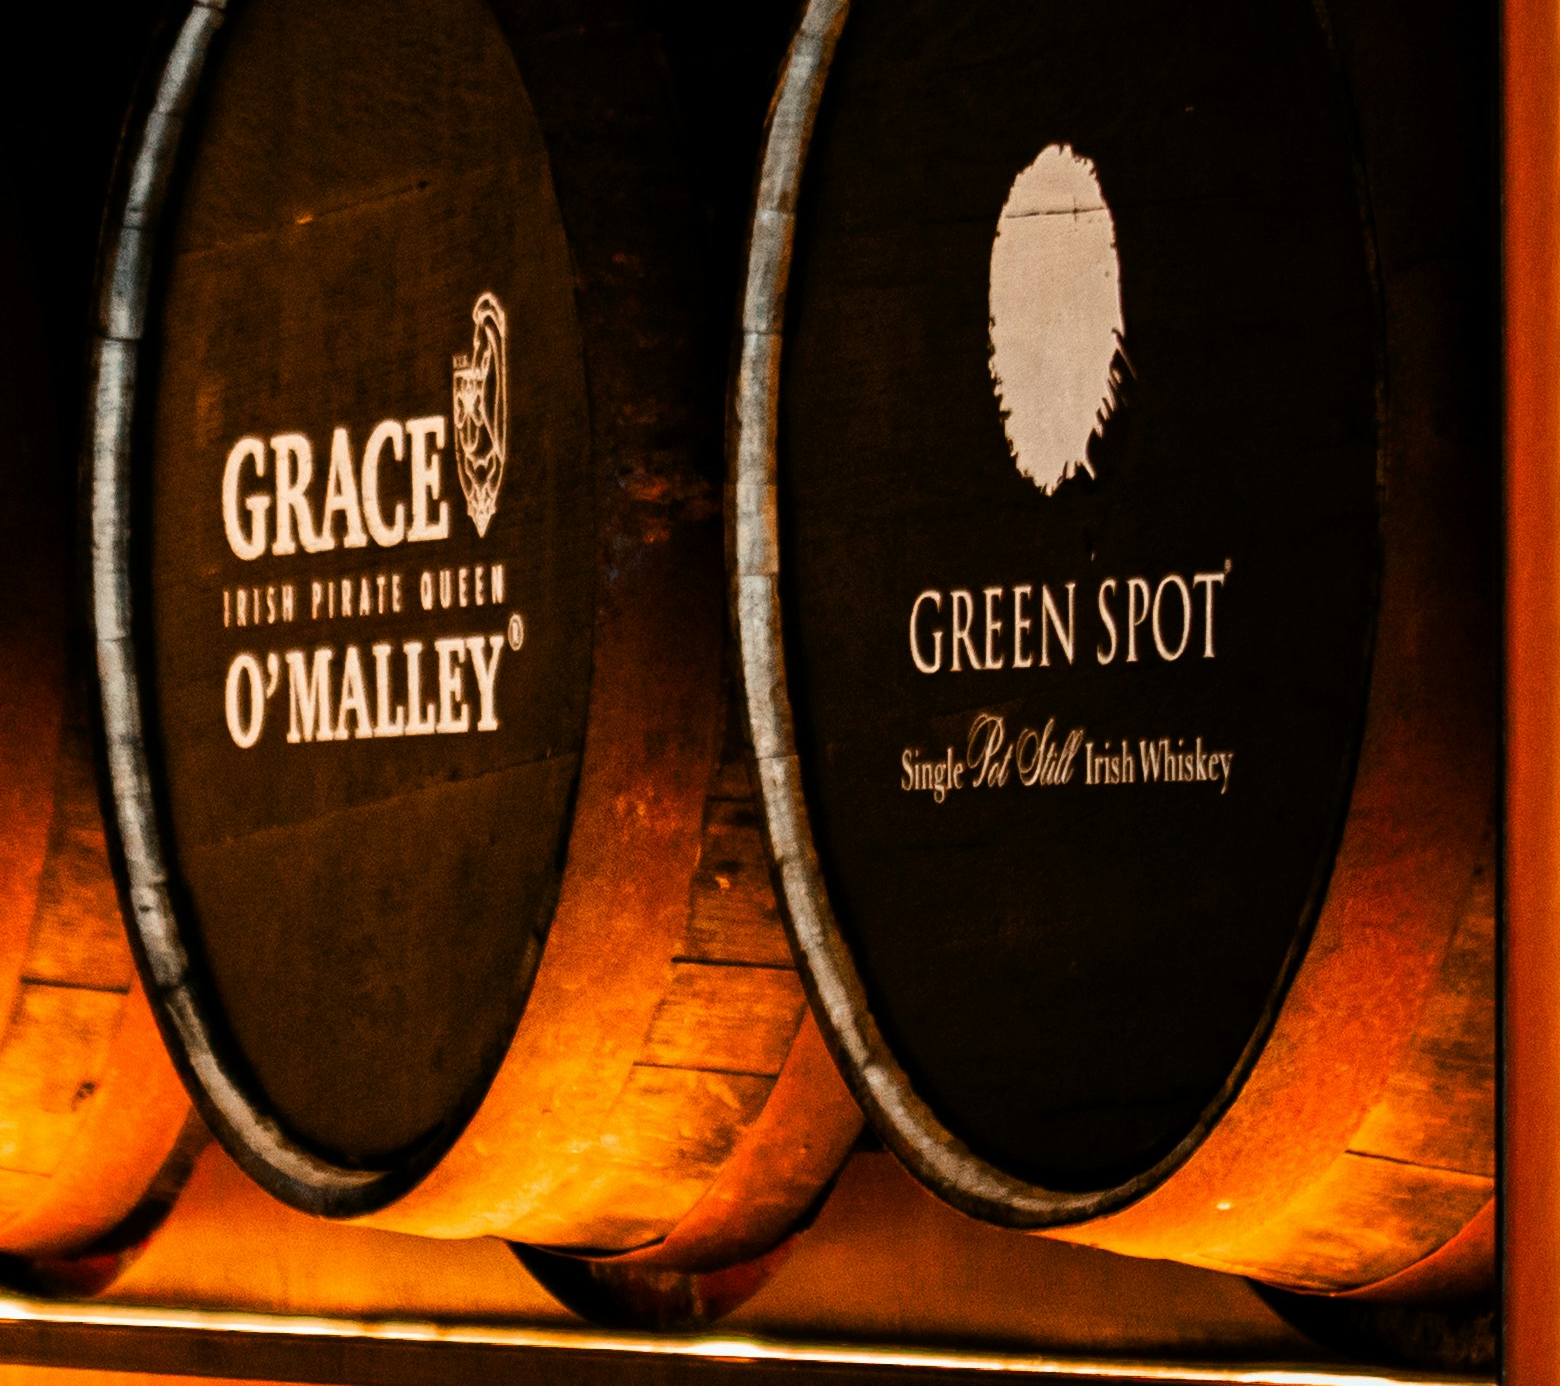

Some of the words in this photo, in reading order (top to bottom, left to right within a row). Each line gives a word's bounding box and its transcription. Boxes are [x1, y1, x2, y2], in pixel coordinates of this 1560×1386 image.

[222, 413, 448, 561] GRACE
[222, 583, 296, 628] IRISH
[310, 575, 403, 620] PIRATE
[420, 565, 505, 611] QUEEN
[908, 580, 1078, 674] GREEN
[1096, 570, 1227, 666] SPOT
[900, 744, 966, 805] Single
[967, 712, 1013, 789] Pot
[1016, 716, 1085, 787] Still
[1085, 738, 1136, 785] Irish
[1139, 736, 1235, 795] Whiskey
